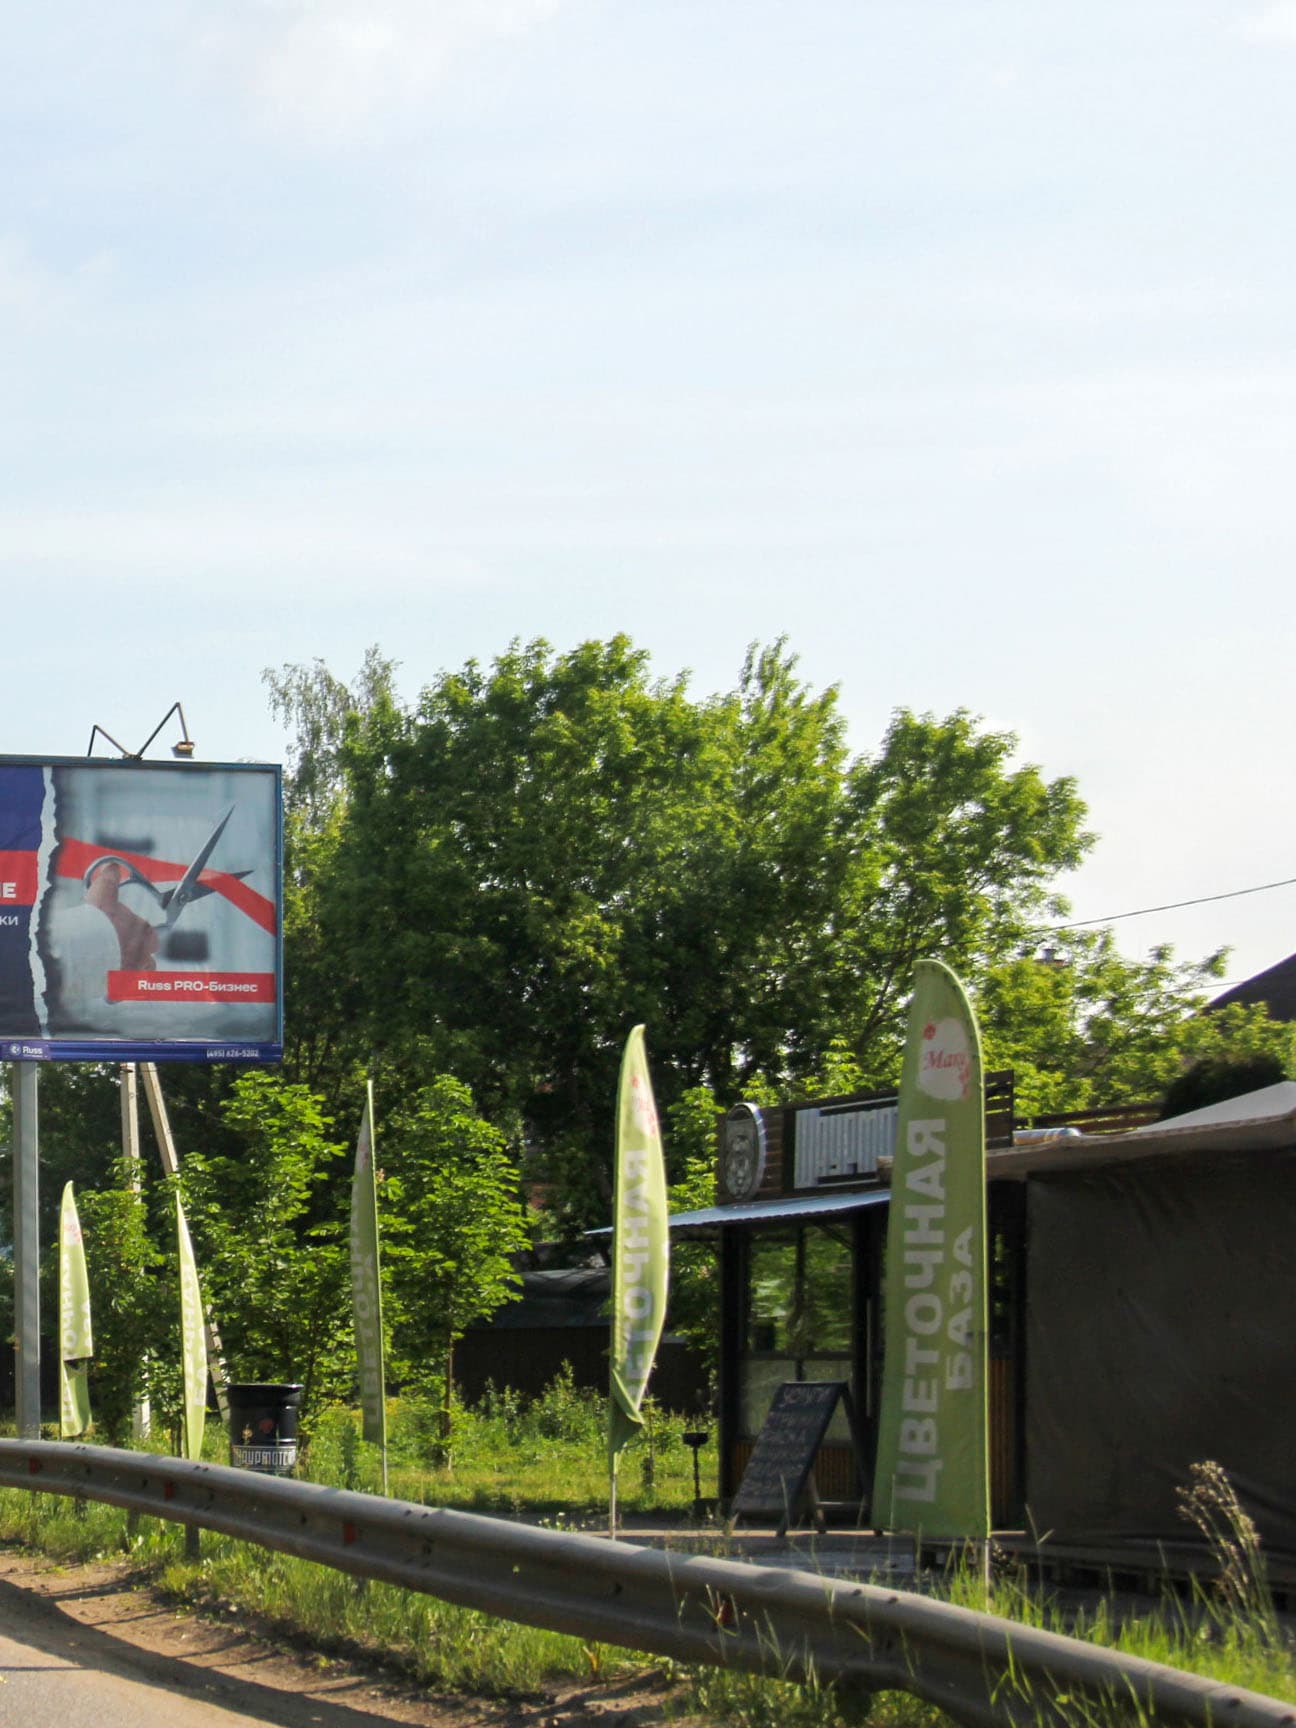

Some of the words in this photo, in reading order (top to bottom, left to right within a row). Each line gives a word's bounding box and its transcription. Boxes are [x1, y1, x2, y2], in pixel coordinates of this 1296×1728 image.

[138, 980, 171, 991] Russ
[174, 981, 258, 993] PRO-Бизнес
[22, 1046, 43, 1054] Russ
[894, 1118, 946, 1503] ЦВЕТОЧНАЯ
[946, 1225, 974, 1390] БАЗА
